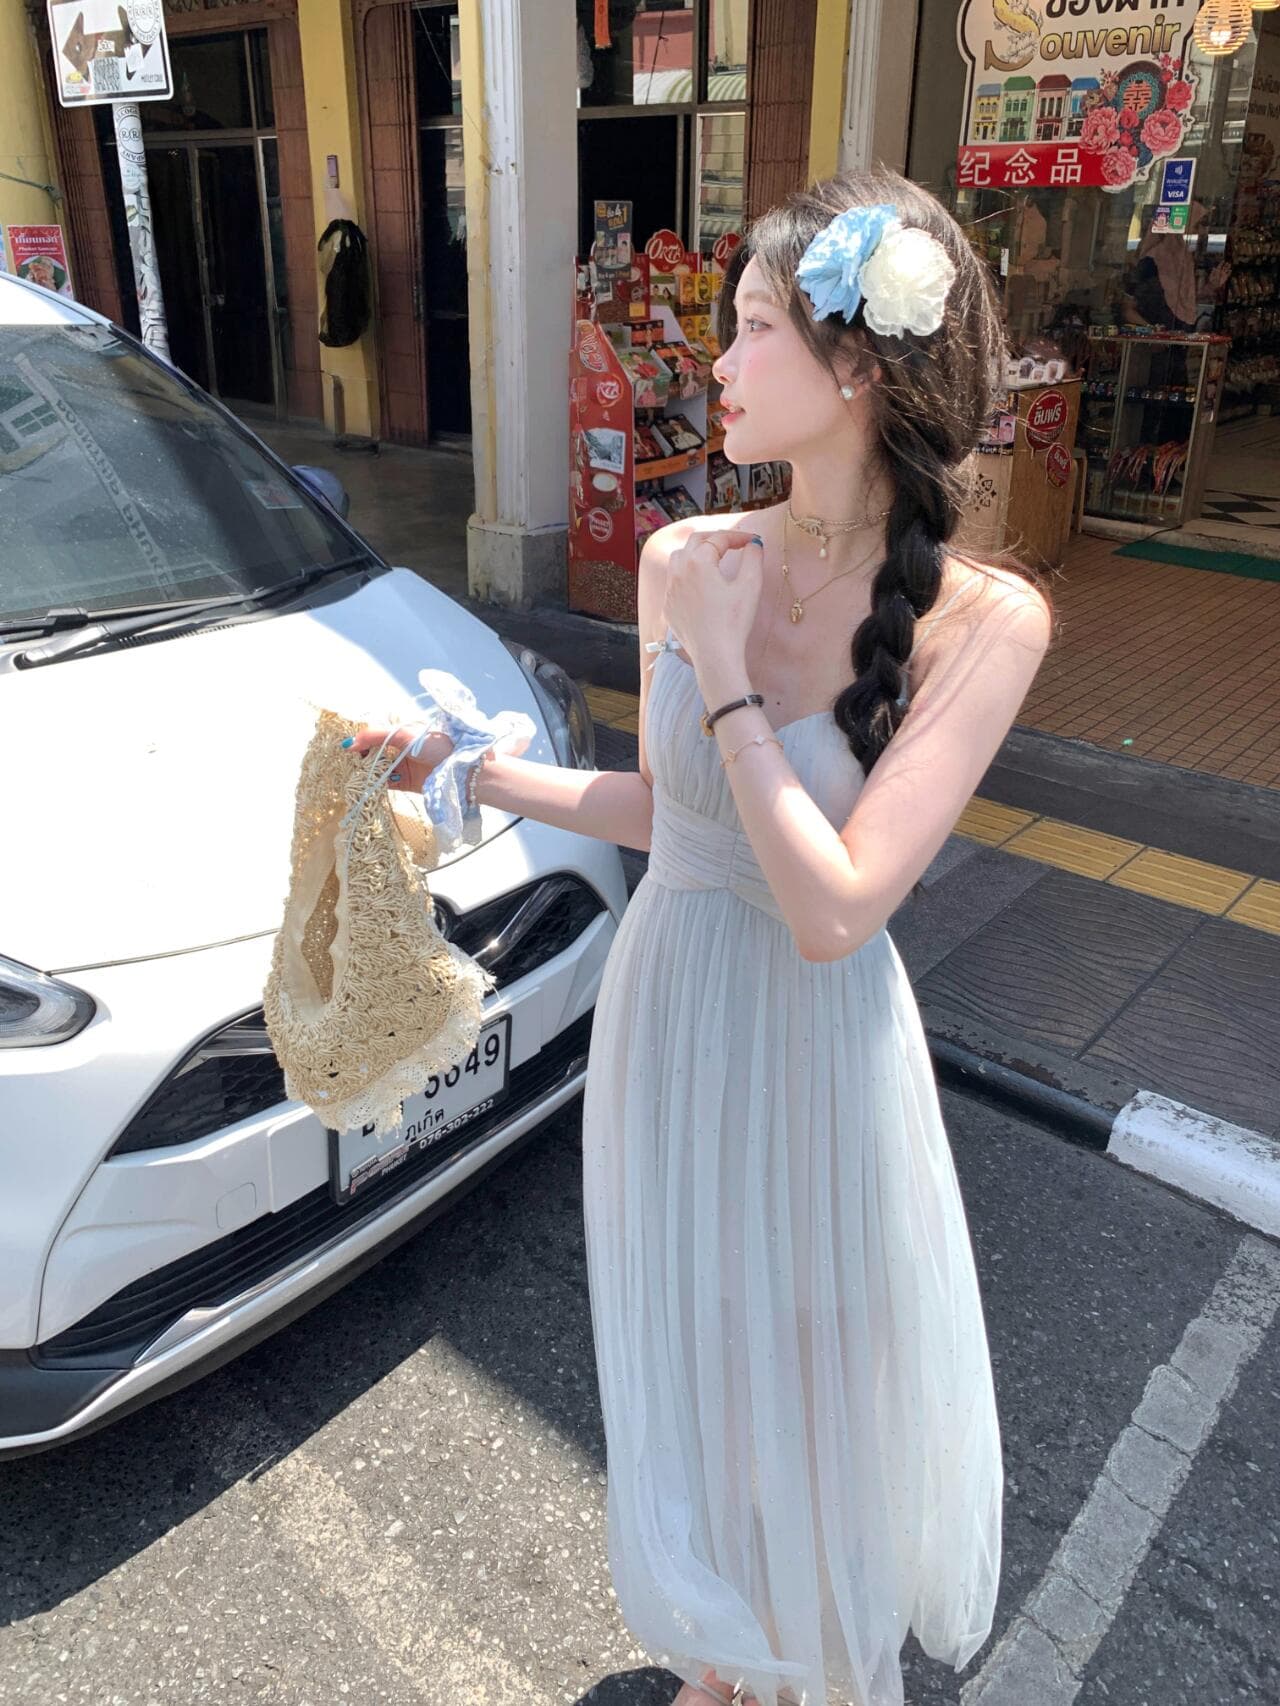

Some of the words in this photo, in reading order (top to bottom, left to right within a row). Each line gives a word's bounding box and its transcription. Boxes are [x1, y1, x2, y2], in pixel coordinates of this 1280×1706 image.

[959, 148, 1082, 186] 纪念品
[1167, 190, 1184, 199] VISA
